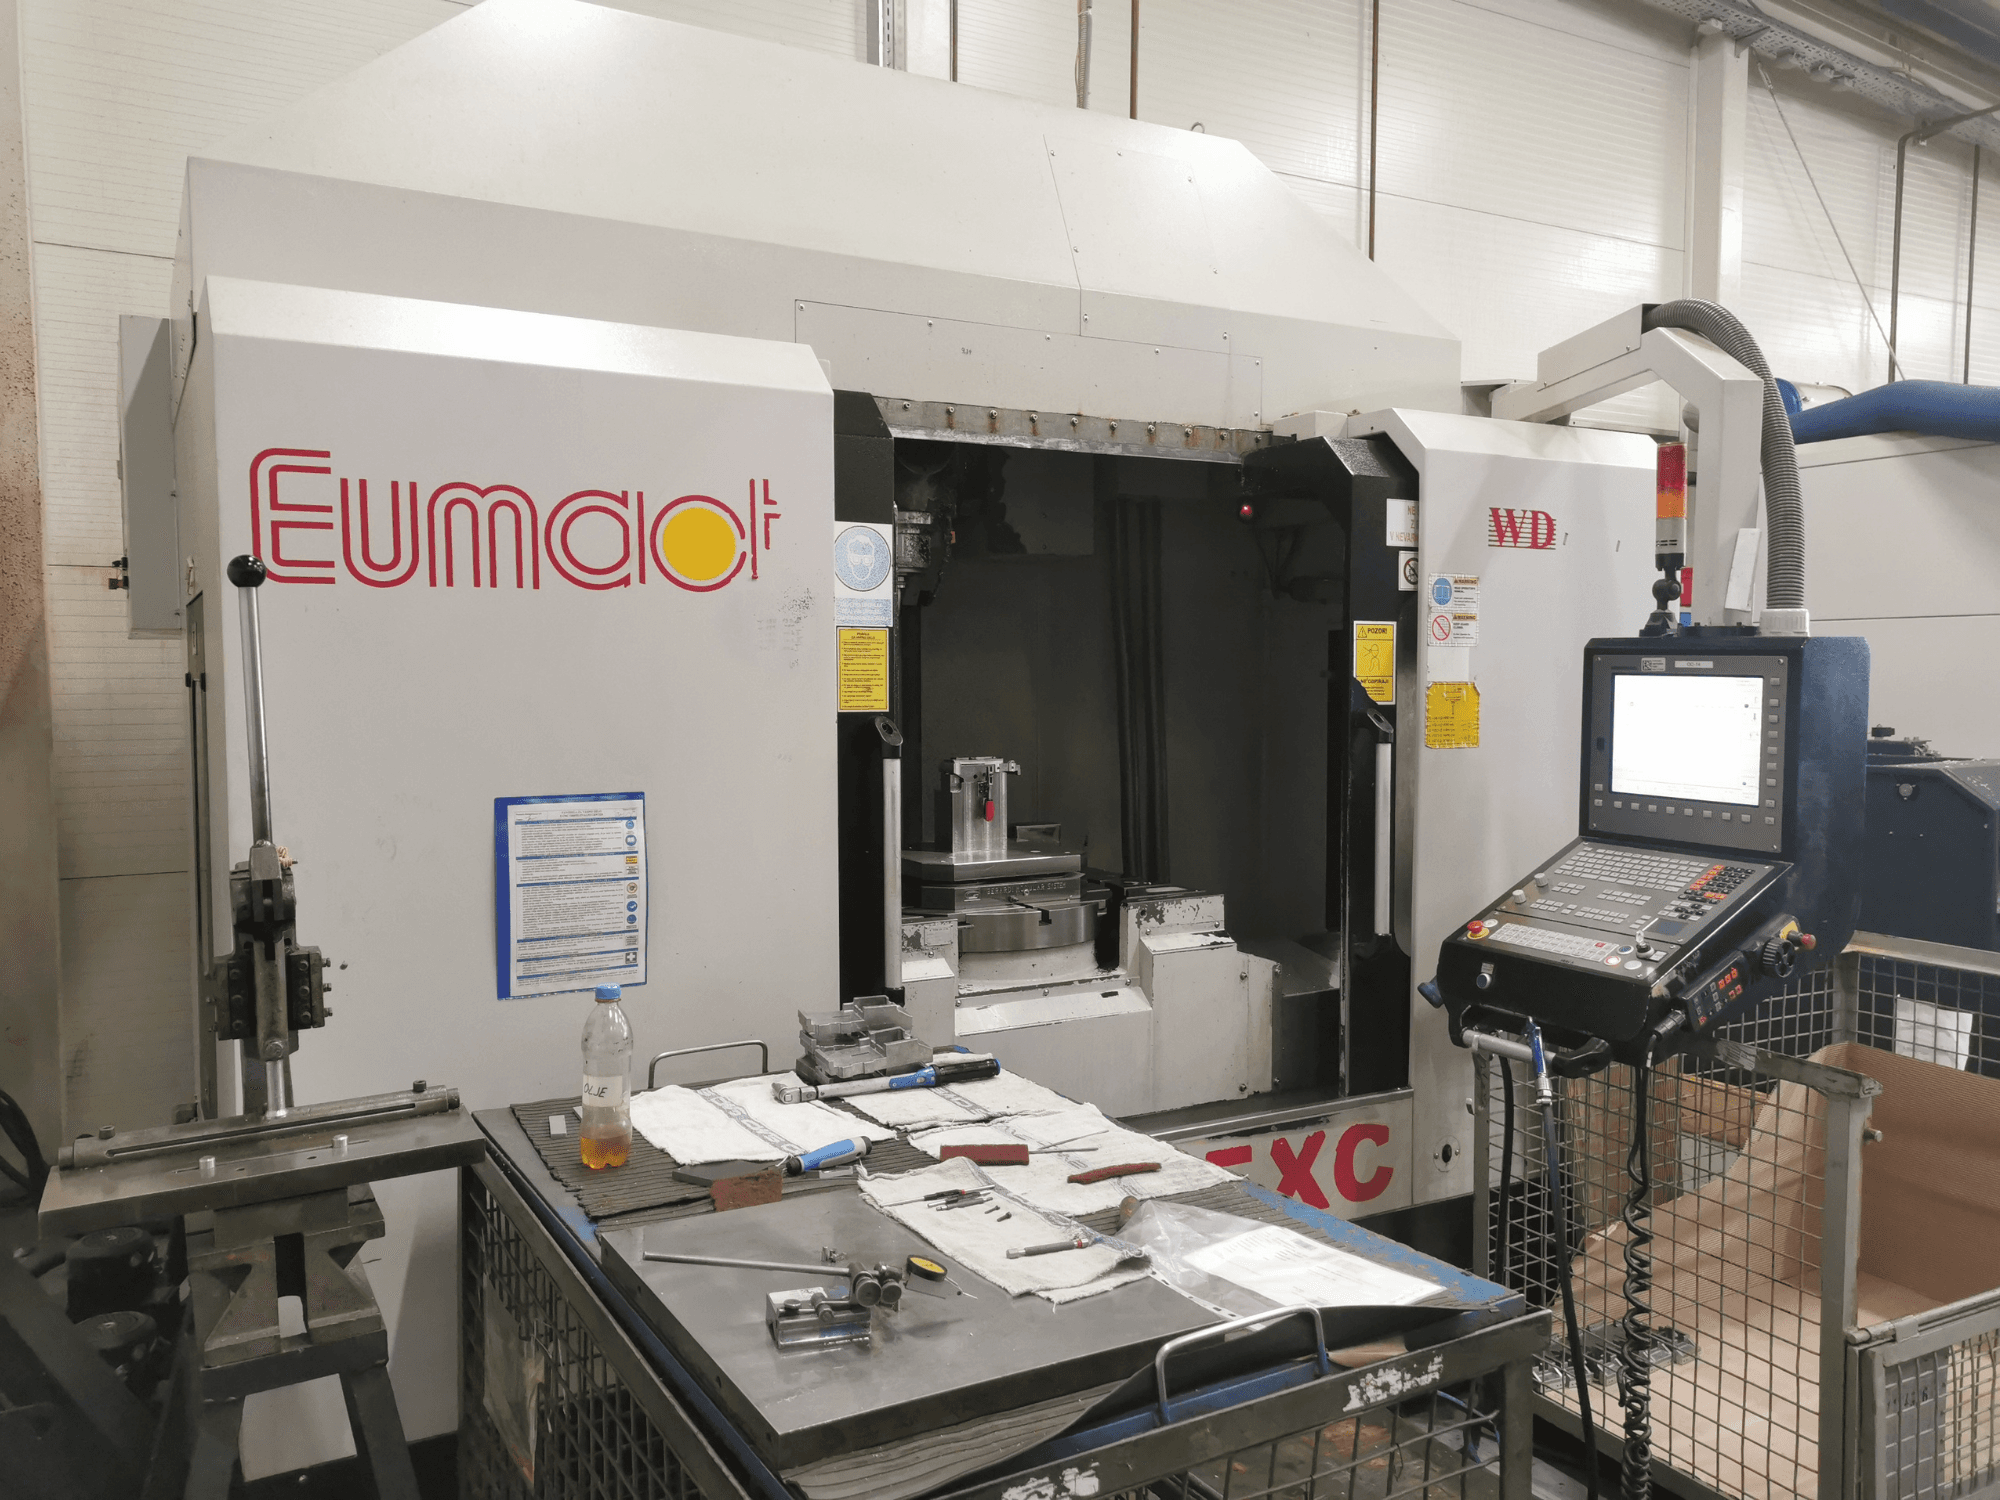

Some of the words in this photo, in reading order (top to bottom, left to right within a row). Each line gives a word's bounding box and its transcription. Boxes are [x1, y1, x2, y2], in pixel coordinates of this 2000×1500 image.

[1488, 506, 1556, 551] WD
[1367, 627, 1388, 635] POZOR!
[583, 1082, 608, 1098] OLJE
